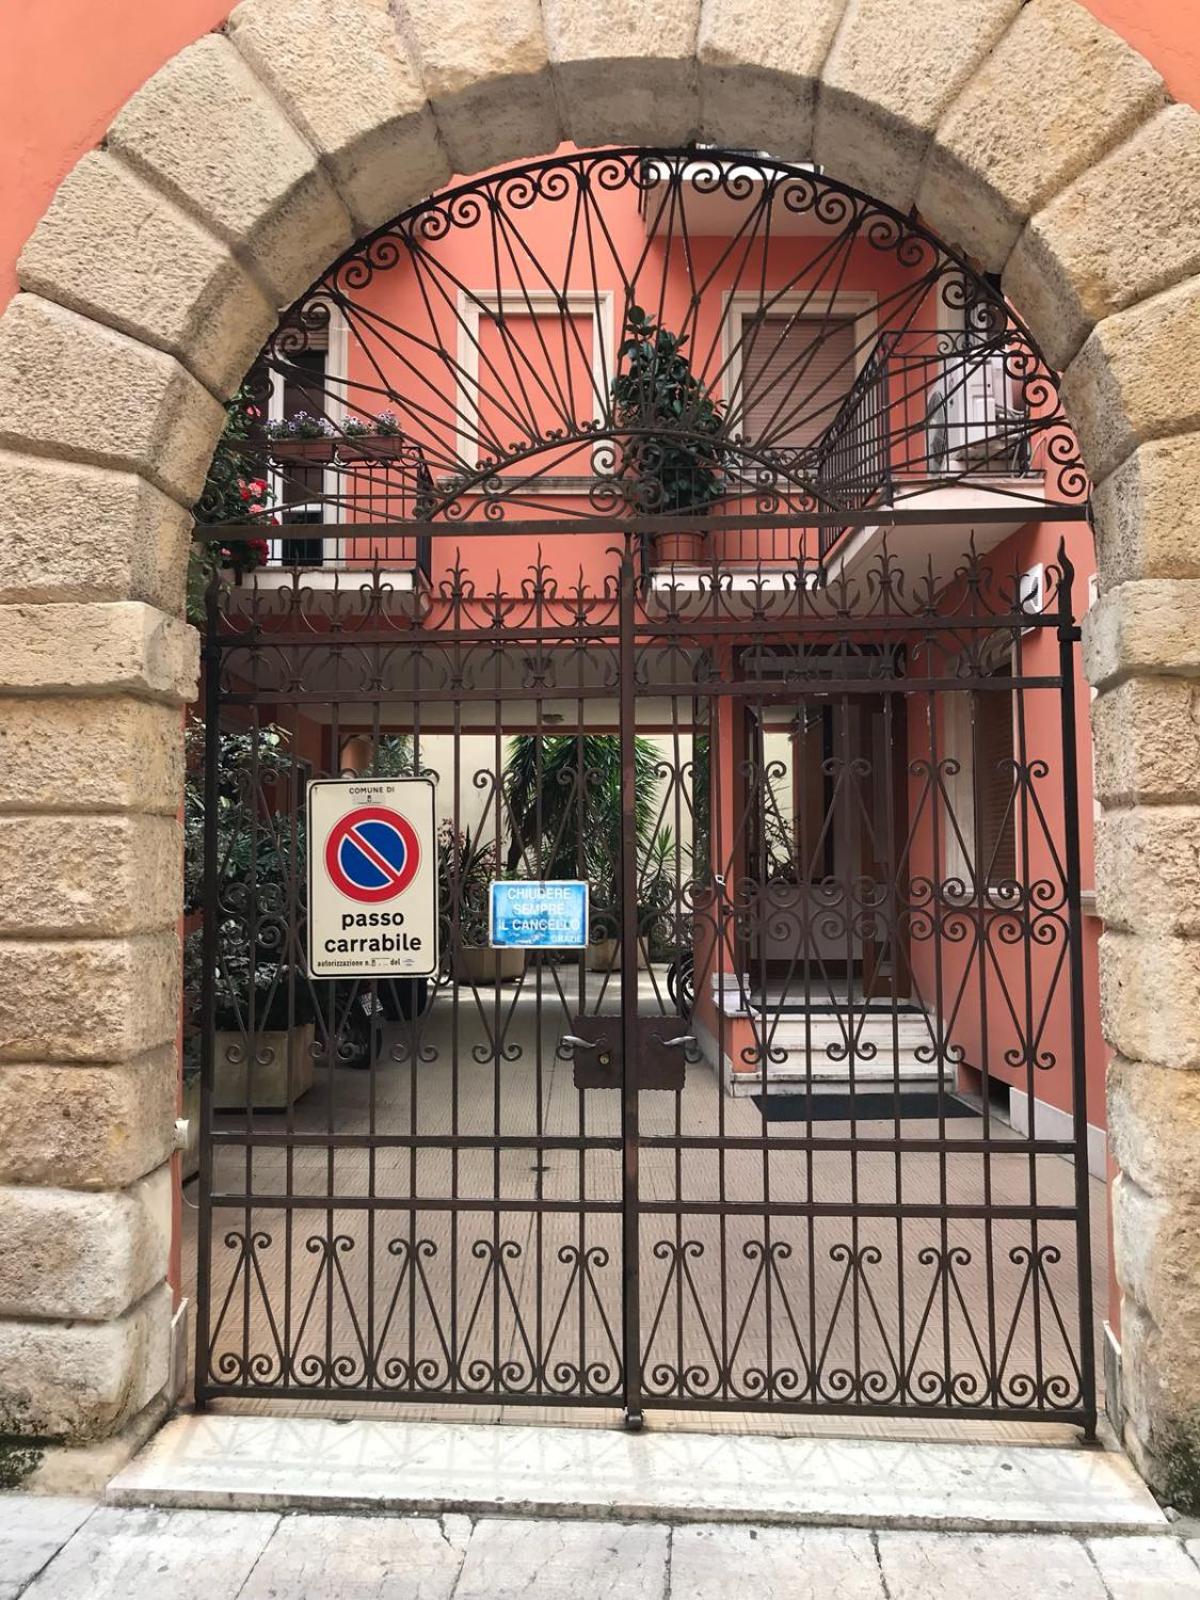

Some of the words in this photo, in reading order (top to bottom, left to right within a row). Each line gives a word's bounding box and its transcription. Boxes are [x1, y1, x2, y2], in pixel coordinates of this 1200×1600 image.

[507, 887, 572, 900] CHIUDERE
[513, 903, 565, 915] SEMPRE
[341, 912, 405, 930] passo
[498, 919, 509, 931] IL
[512, 919, 580, 931] CANCELLO
[324, 933, 422, 953] carrabile
[317, 958, 363, 967] autorizzazione
[390, 958, 401, 966] del
